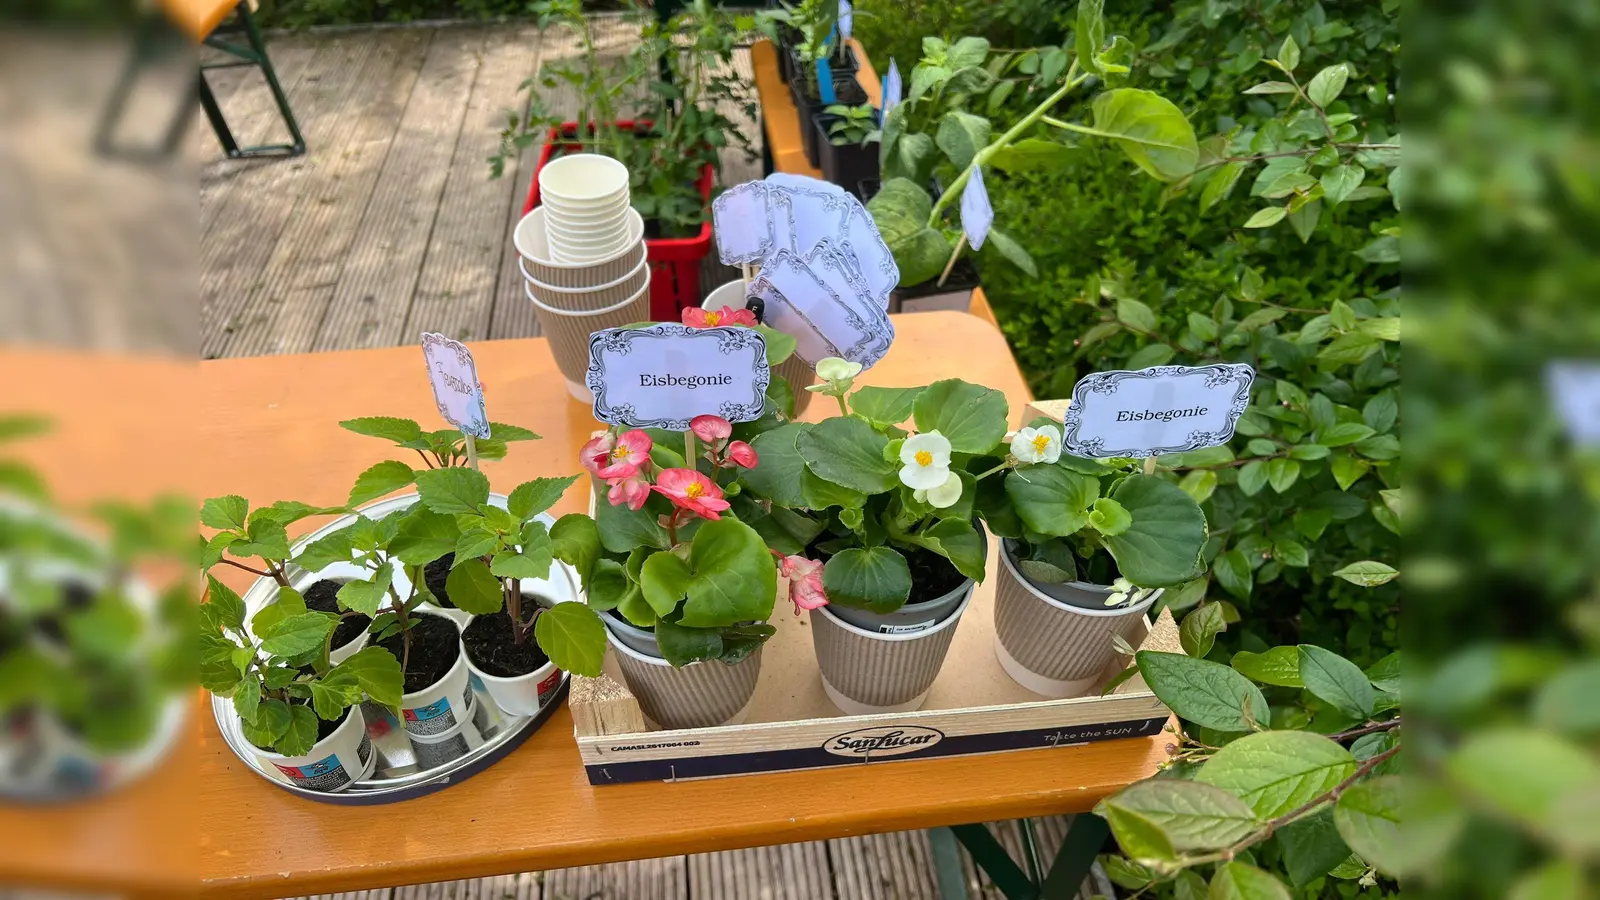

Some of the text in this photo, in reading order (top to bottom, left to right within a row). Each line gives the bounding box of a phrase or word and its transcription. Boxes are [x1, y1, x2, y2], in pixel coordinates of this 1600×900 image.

[639, 373, 733, 389] Eisbegonie
[1115, 405, 1209, 423] Eisbegonie
[1043, 733, 1077, 741] Taste
[1104, 727, 1132, 736] SUN
